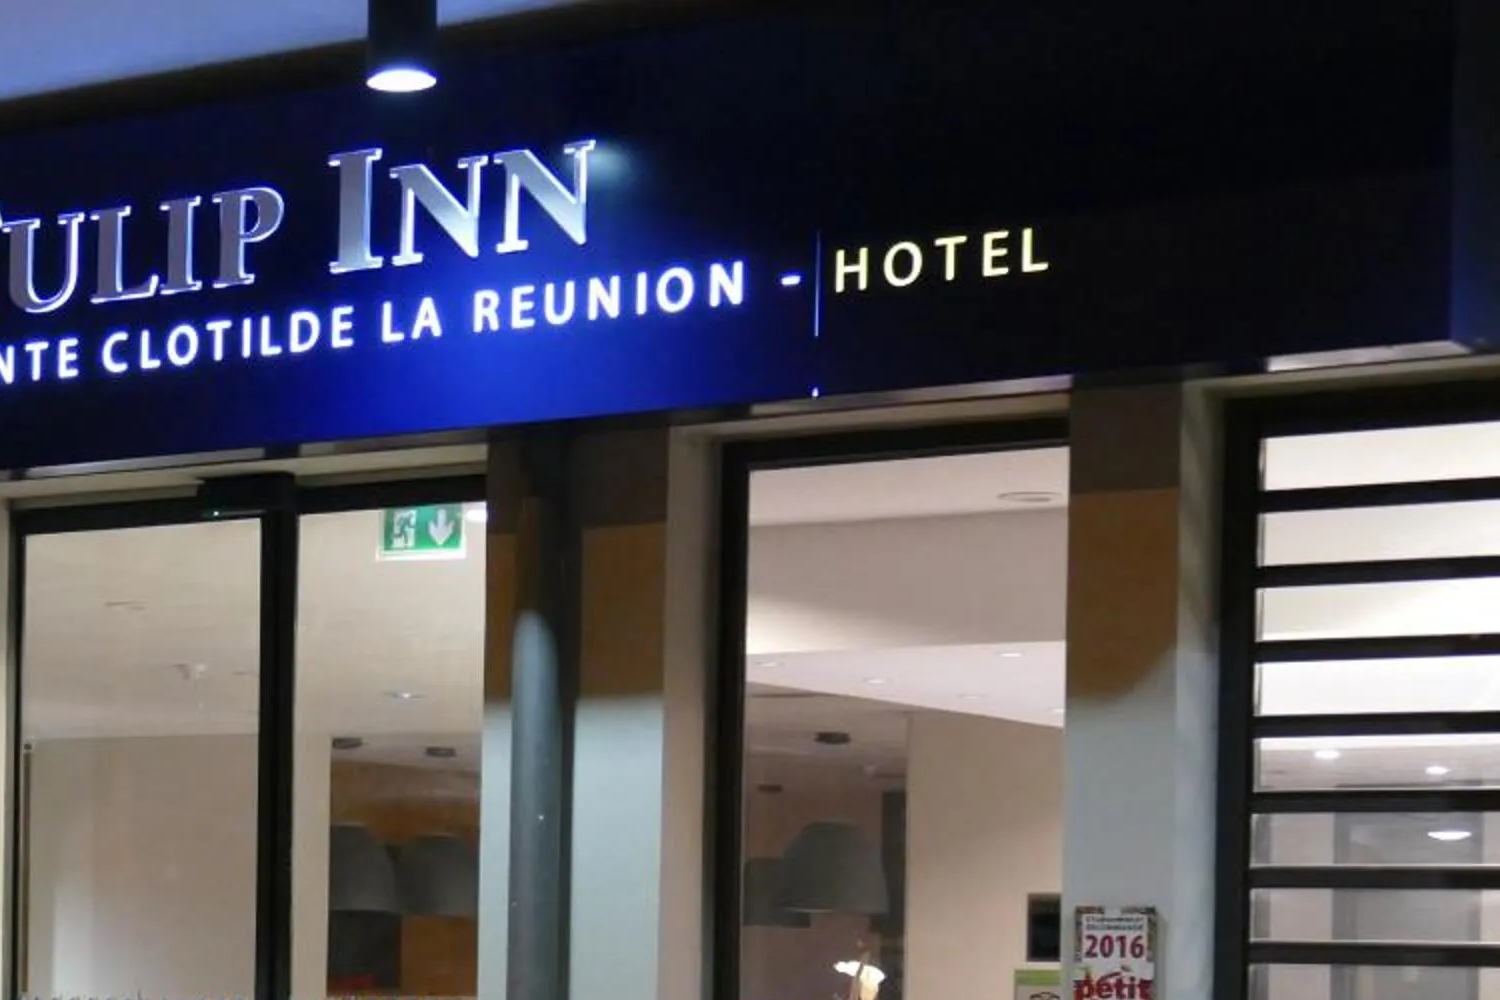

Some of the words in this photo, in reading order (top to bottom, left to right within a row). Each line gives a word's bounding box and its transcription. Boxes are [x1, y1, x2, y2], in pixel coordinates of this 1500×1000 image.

[328, 139, 596, 274] INN
[101, 306, 354, 374] CLOTILDE
[381, 298, 443, 343] LA
[472, 260, 745, 334] REUNION
[835, 227, 1049, 293] HOTEL
[1084, 934, 1145, 959] 2016
